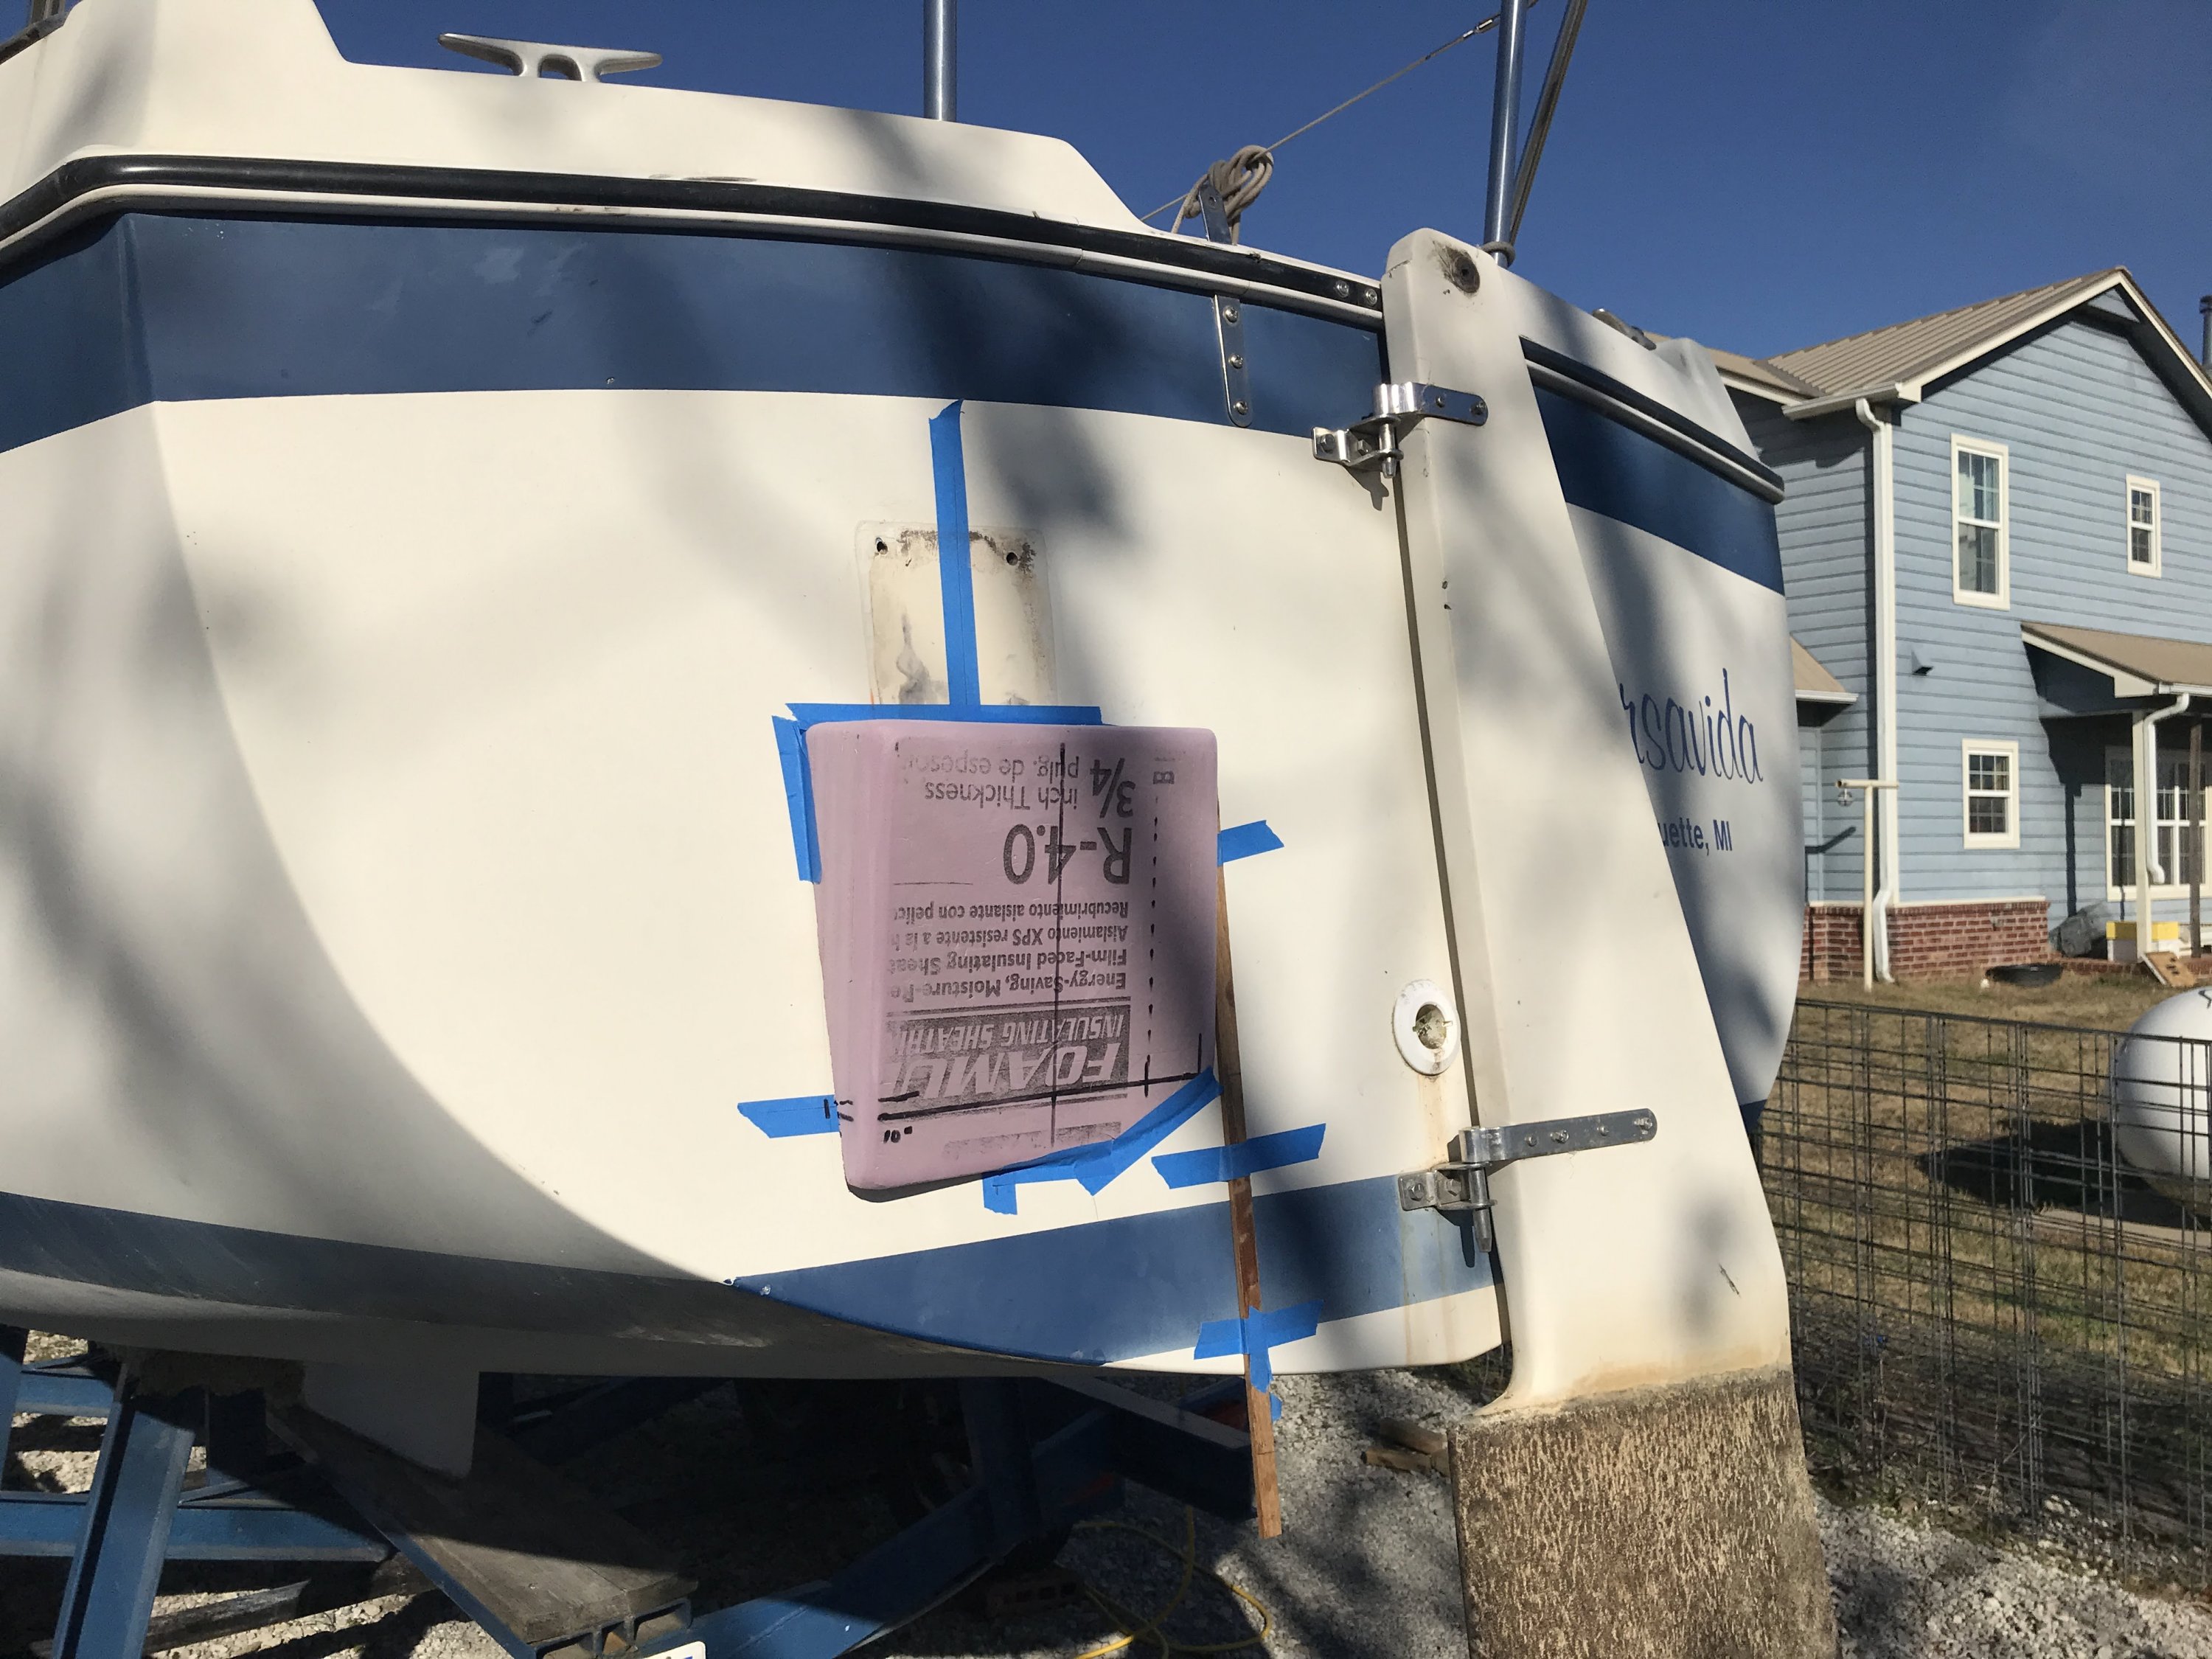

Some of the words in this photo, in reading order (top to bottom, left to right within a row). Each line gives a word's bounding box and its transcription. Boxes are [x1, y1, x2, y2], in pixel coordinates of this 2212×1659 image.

[1620, 668, 1763, 784] rsavida
[998, 758, 1025, 783] de
[1033, 754, 1079, 785] pulg.
[925, 782, 1031, 810] Thickness
[1037, 786, 1078, 811] inch
[1090, 757, 1136, 818] 3/4
[1657, 817, 1710, 855] uette,
[1713, 819, 1733, 851] MI
[1004, 824, 1133, 886] R-4.0
[938, 905, 965, 919] con
[969, 904, 1025, 922] aislante
[1029, 901, 1129, 920] Recubrimiento
[922, 931, 932, 945] a
[936, 929, 1008, 948] resistente
[1012, 928, 1044, 946] XPS
[1047, 925, 1128, 944] Aislamiento
[946, 950, 1032, 973] Insulating
[1037, 948, 1127, 970] Film-Faced
[1005, 970, 1127, 995] Energy-Saving,
[895, 1023, 995, 1056] SHEATHI
[1001, 1014, 1124, 1047] INSULATING
